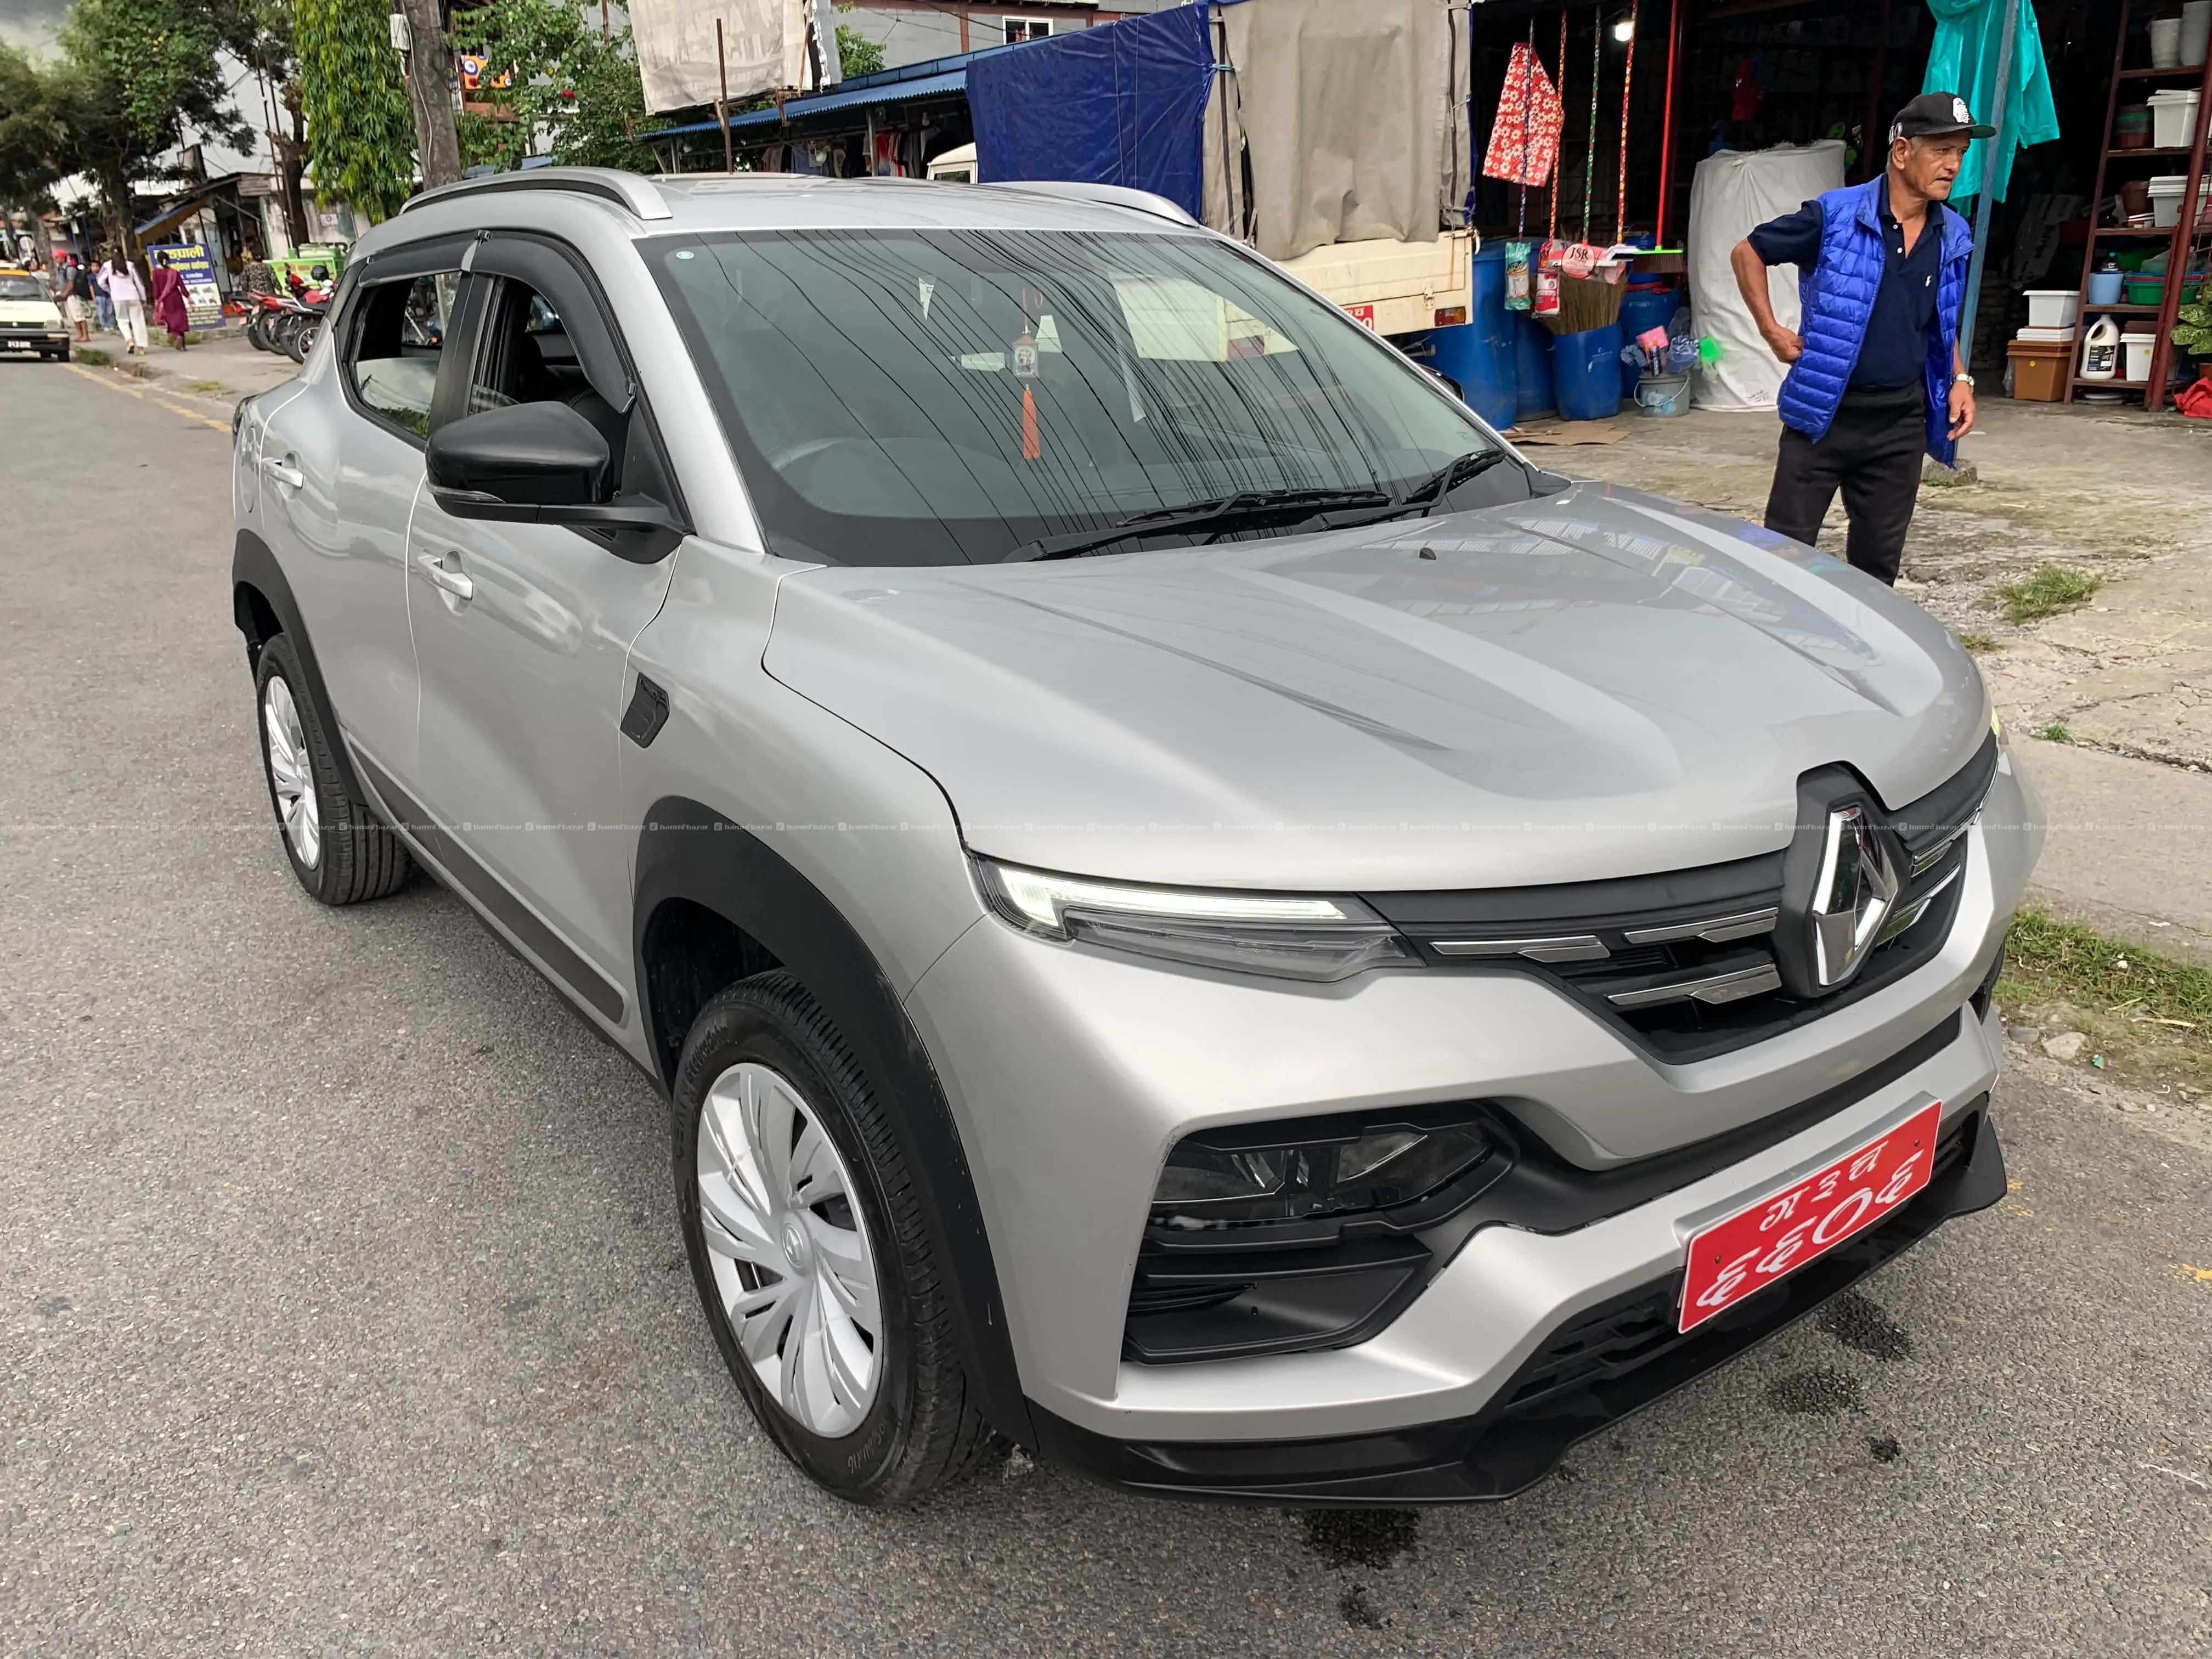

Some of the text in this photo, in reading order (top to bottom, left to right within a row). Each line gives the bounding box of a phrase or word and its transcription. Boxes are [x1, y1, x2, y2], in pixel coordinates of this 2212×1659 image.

[1568, 247, 1589, 259] JSR
[1810, 1170, 1841, 1203] ३
[1848, 1140, 1889, 1182] च
